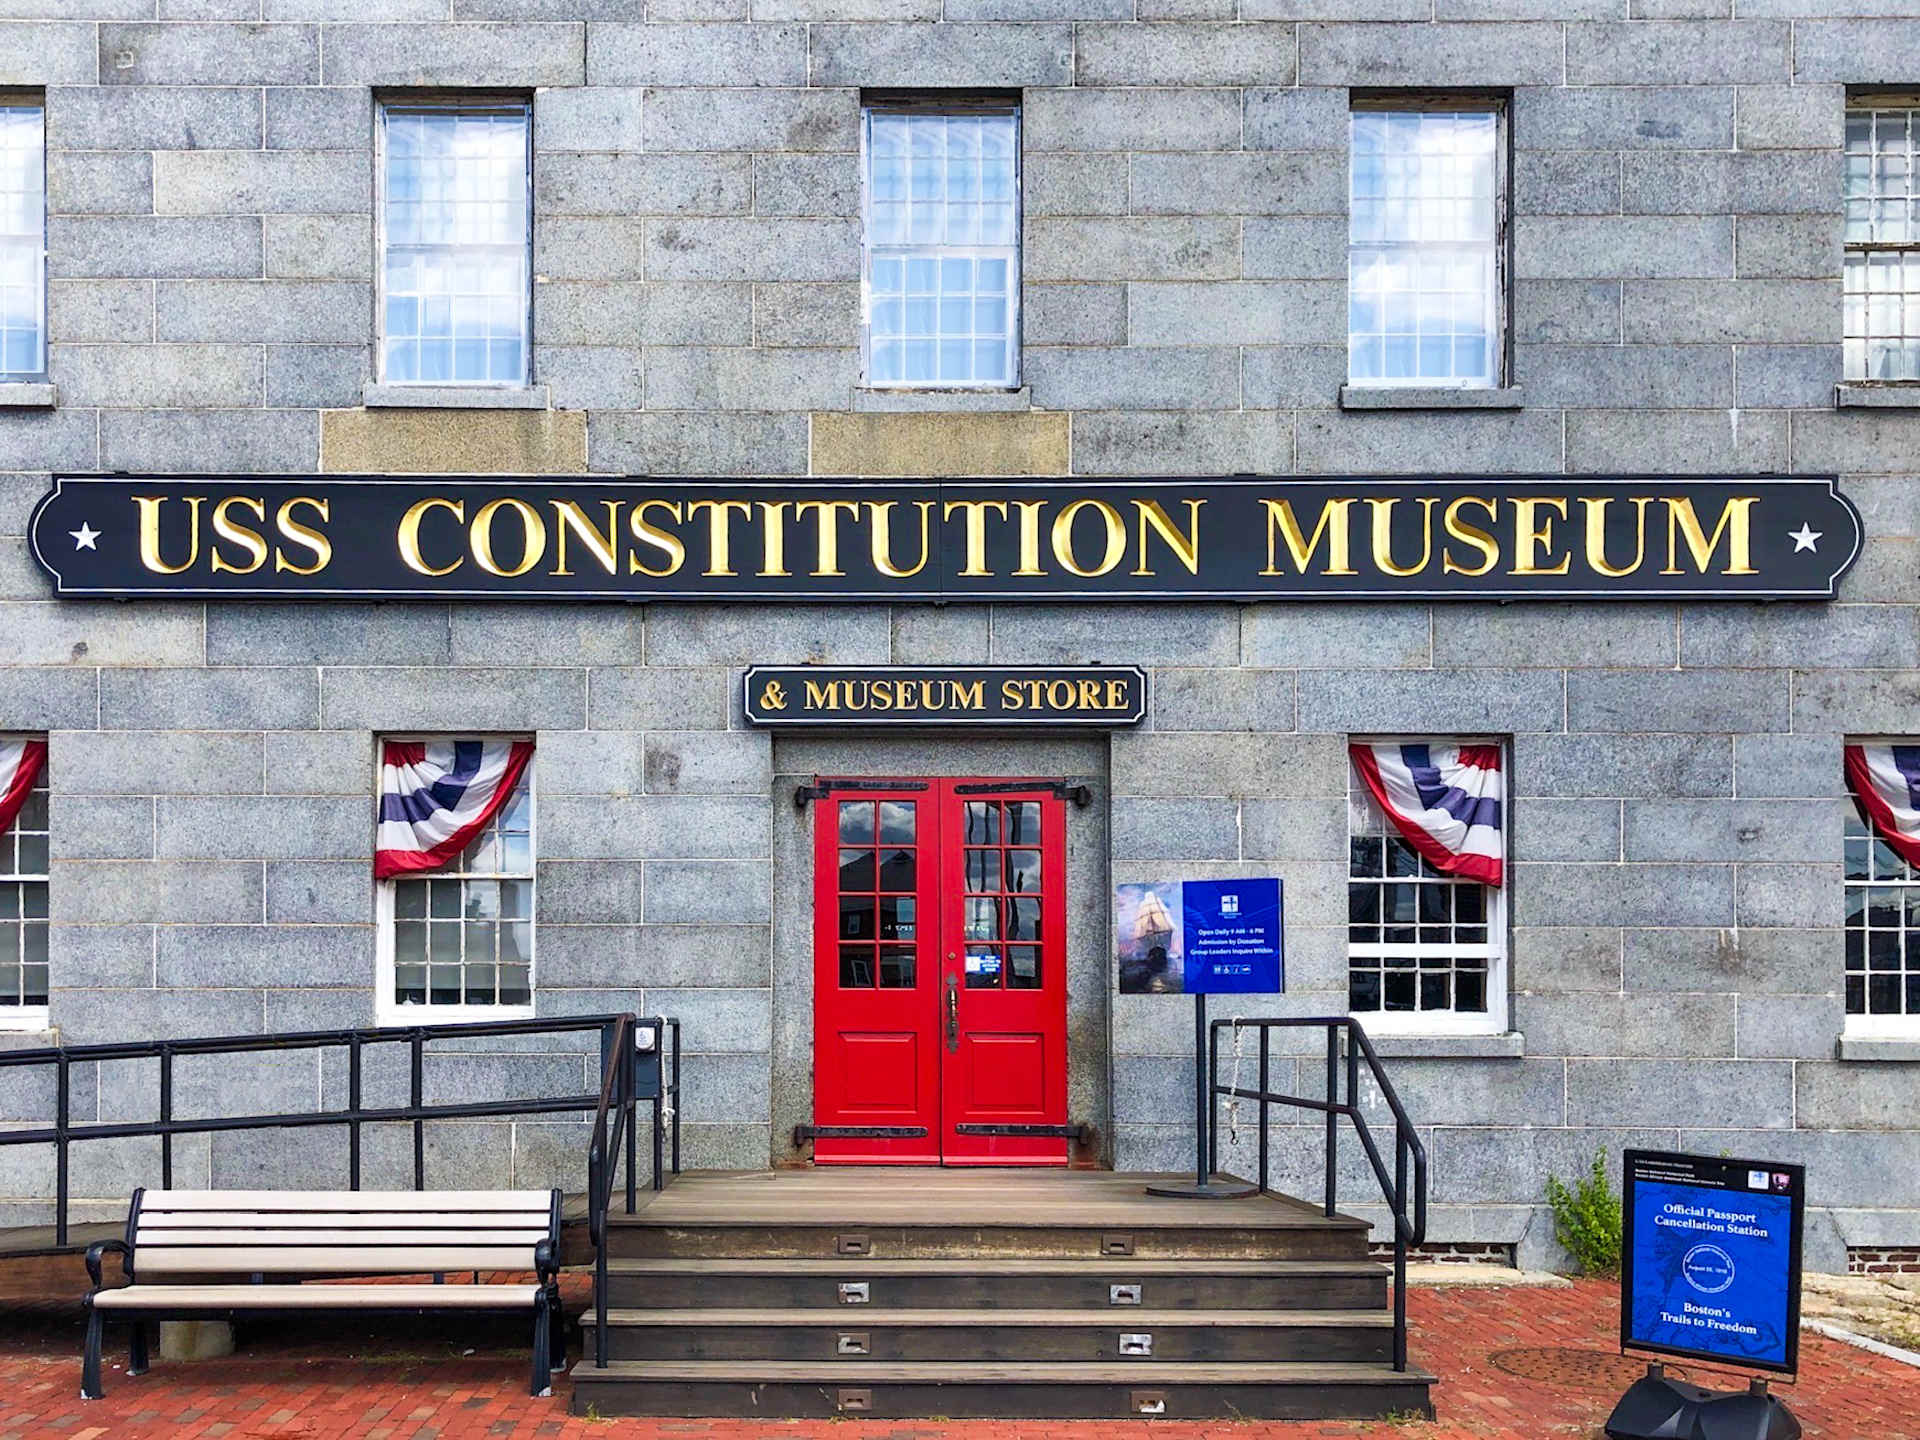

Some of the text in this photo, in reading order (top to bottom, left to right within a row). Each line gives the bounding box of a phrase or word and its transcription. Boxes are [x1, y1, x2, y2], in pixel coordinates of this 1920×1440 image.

[131, 495, 1761, 578] USS CONSTITUTION MUSEUM
[759, 679, 1129, 711] & MUSEUM STORE
[1198, 929, 1214, 937] Open
[1215, 928, 1229, 936] Daily
[1190, 948, 1208, 956] Group
[1663, 1203, 1756, 1223] Official Passport
[1654, 1215, 1768, 1237] Cancellation Station
[1683, 1302, 1731, 1318] Boston's
[1660, 1311, 1757, 1335] Trails to Freedom
